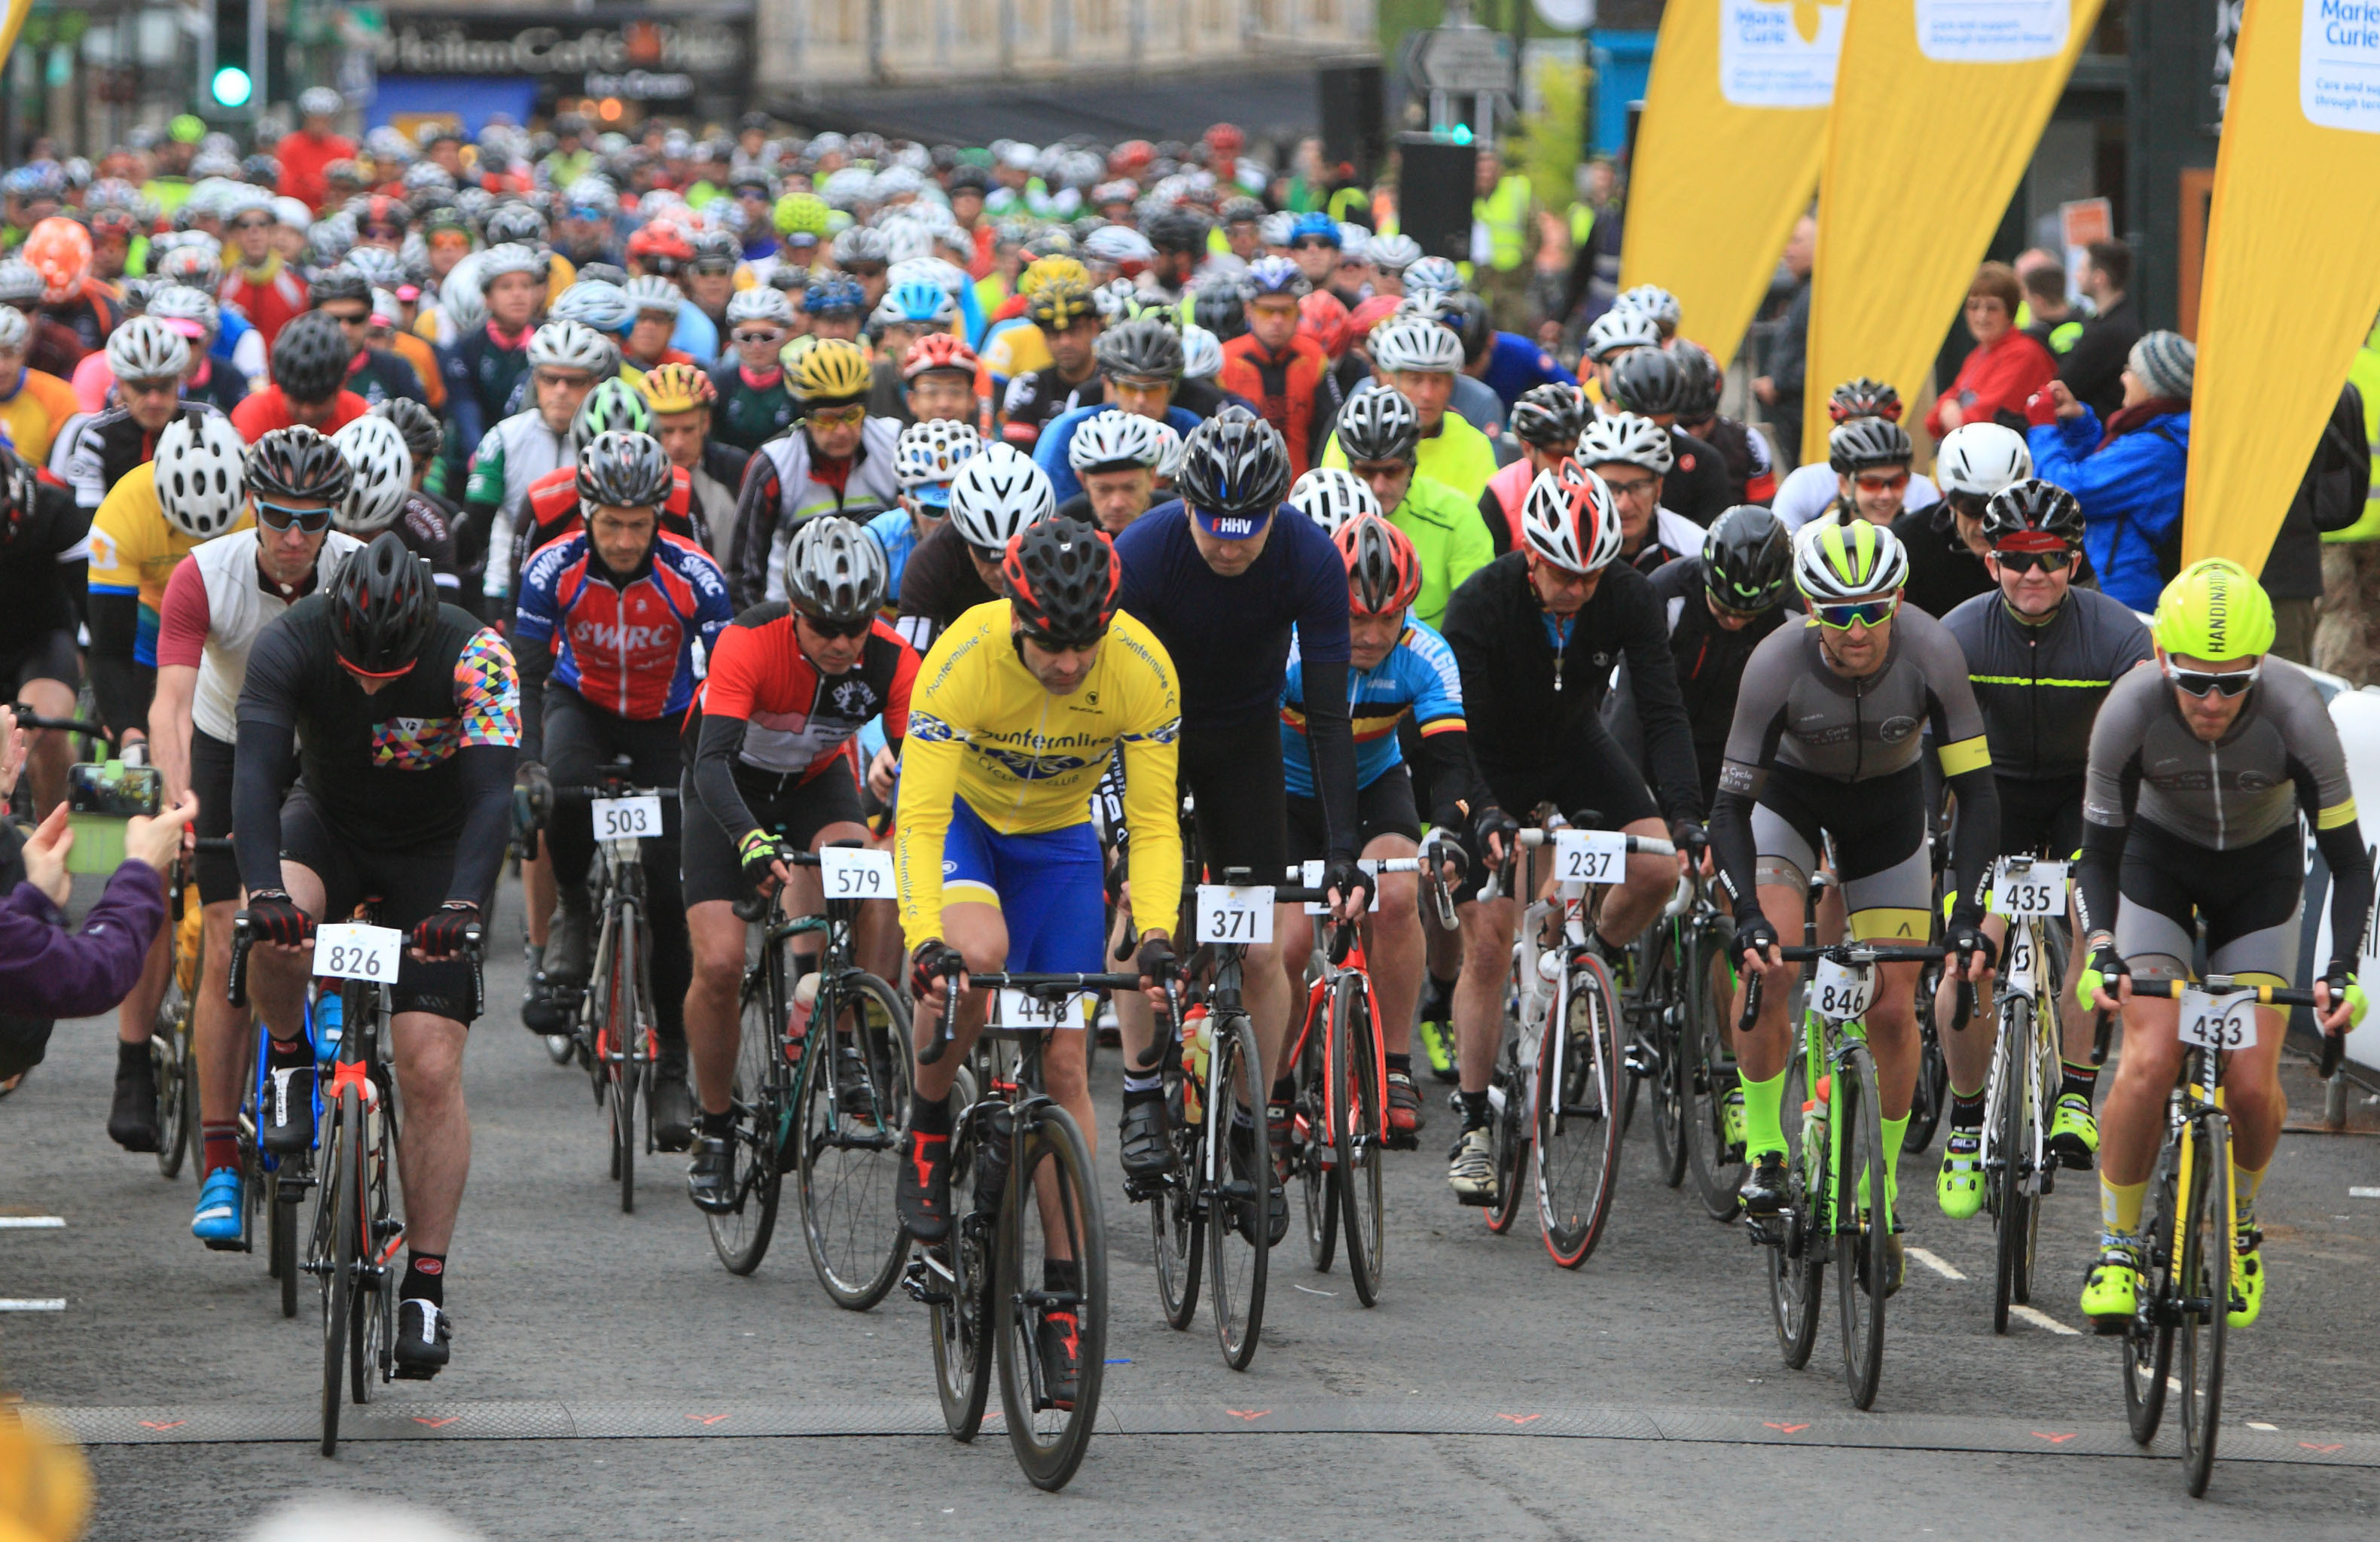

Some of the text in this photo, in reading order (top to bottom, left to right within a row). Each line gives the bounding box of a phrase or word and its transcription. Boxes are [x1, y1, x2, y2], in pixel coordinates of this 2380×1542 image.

[2320, 0, 2380, 23] Marie
[2326, 22, 2380, 48] Curie
[2315, 77, 2340, 90] Care
[2344, 80, 2363, 92] and
[2314, 94, 2359, 111] through
[529, 545, 567, 592] SWRC
[679, 555, 724, 597] SWRC
[574, 620, 674, 651] SWRC
[926, 635, 978, 698] Dunfermline
[976, 728, 1112, 750] Dunfermline
[1729, 766, 1753, 782] Cycle
[606, 808, 646, 835] 503
[899, 827, 914, 902] Dunfermline
[1569, 851, 1612, 877] 237
[838, 868, 880, 893] 579
[2006, 885, 2051, 912] 435
[1211, 910, 1256, 938] 371
[329, 946, 380, 976] 826
[1822, 985, 1864, 1015] 846
[2192, 1015, 2243, 1046] 433
